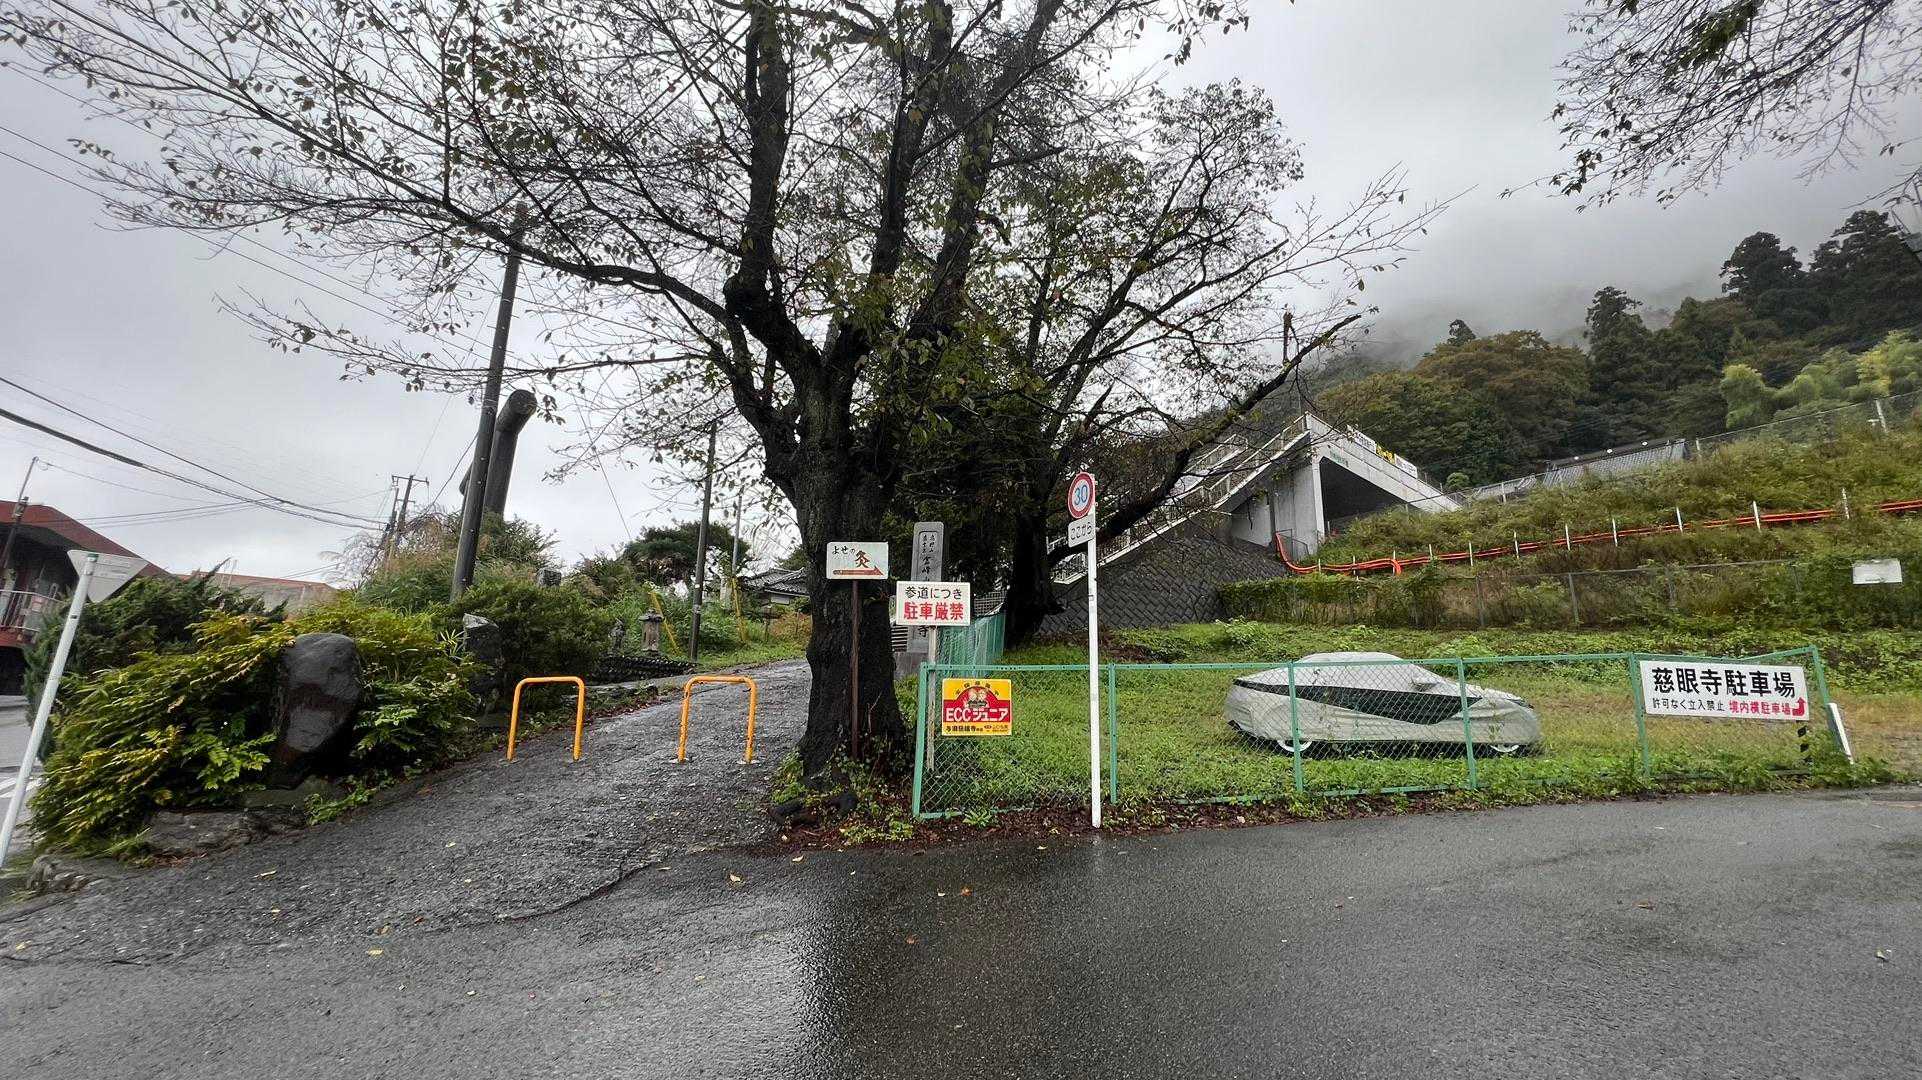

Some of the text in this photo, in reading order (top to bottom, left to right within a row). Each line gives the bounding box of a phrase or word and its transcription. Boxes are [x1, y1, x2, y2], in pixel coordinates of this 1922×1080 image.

[1074, 484, 1088, 506] 30
[1070, 521, 1093, 541] ここから
[904, 586, 963, 600] 参道につき
[903, 601, 964, 621] 駐車厳禁
[1652, 667, 1796, 698] 慈眼寺駐車場
[1652, 697, 1726, 712] 許可なく立入禁止
[1729, 700, 1793, 716] 境内横駐車場
[945, 707, 1009, 722] ECCジュニア
